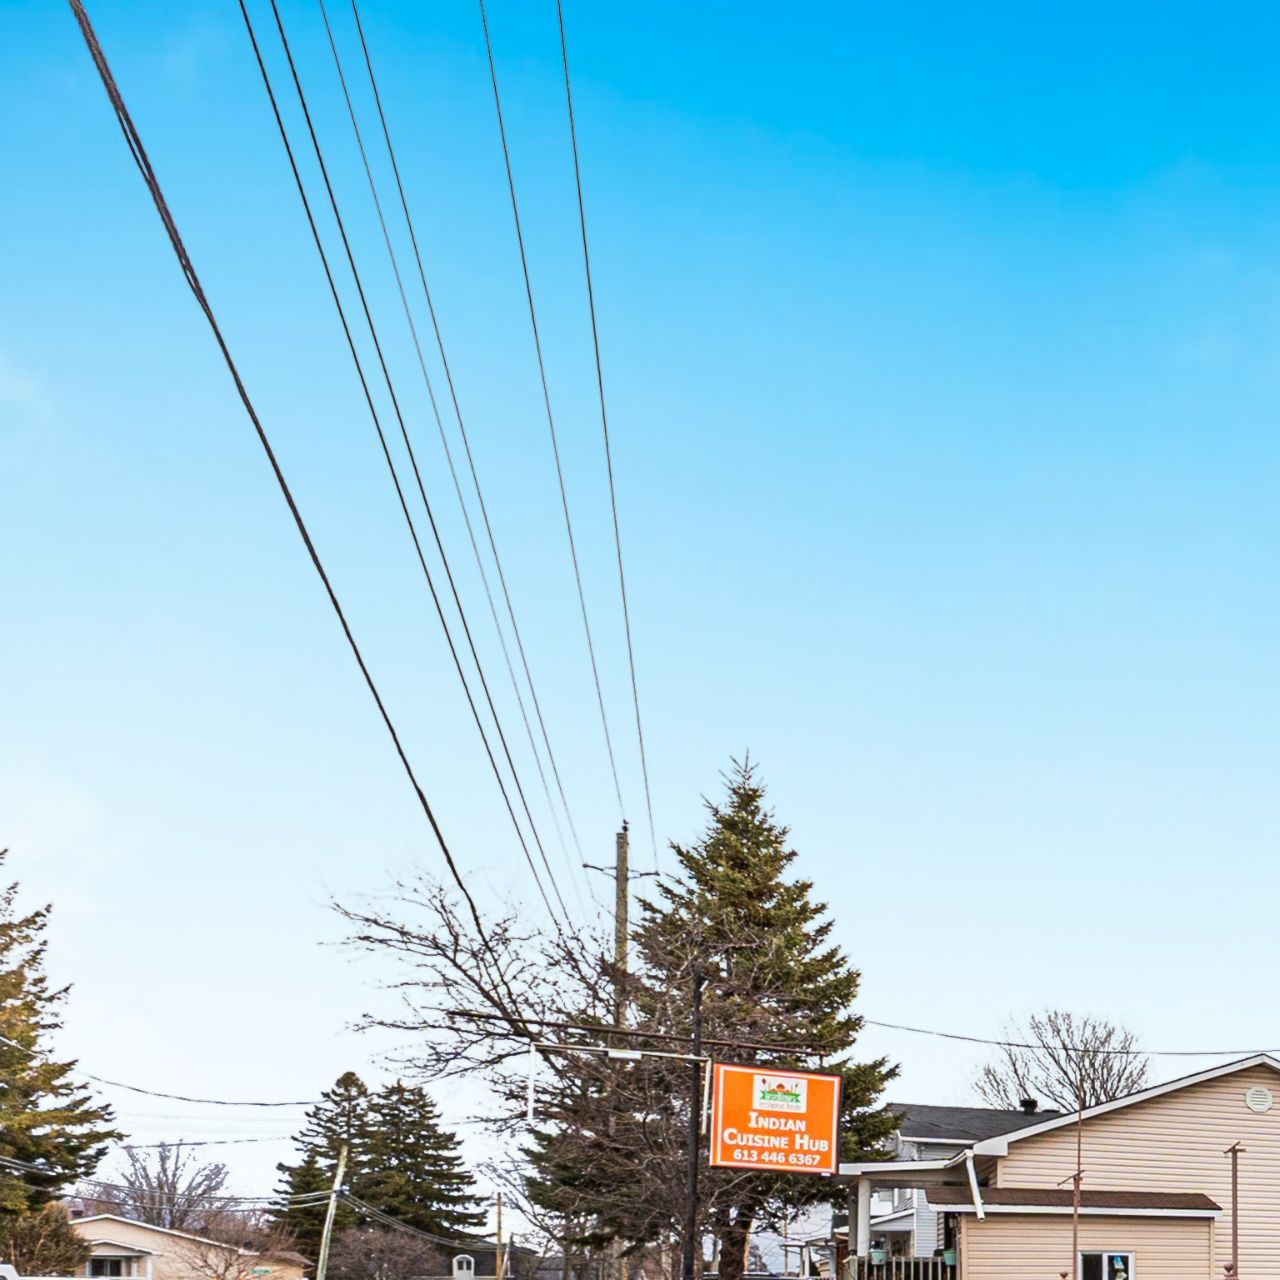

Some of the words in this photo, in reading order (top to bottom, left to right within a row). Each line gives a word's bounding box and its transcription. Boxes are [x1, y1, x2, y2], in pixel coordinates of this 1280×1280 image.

[748, 1111, 806, 1132] INDIAN
[723, 1128, 789, 1149] CUISINE
[795, 1133, 829, 1152] HUB
[733, 1149, 758, 1161] 613
[761, 1151, 785, 1163] 446
[789, 1153, 821, 1166] 6367
